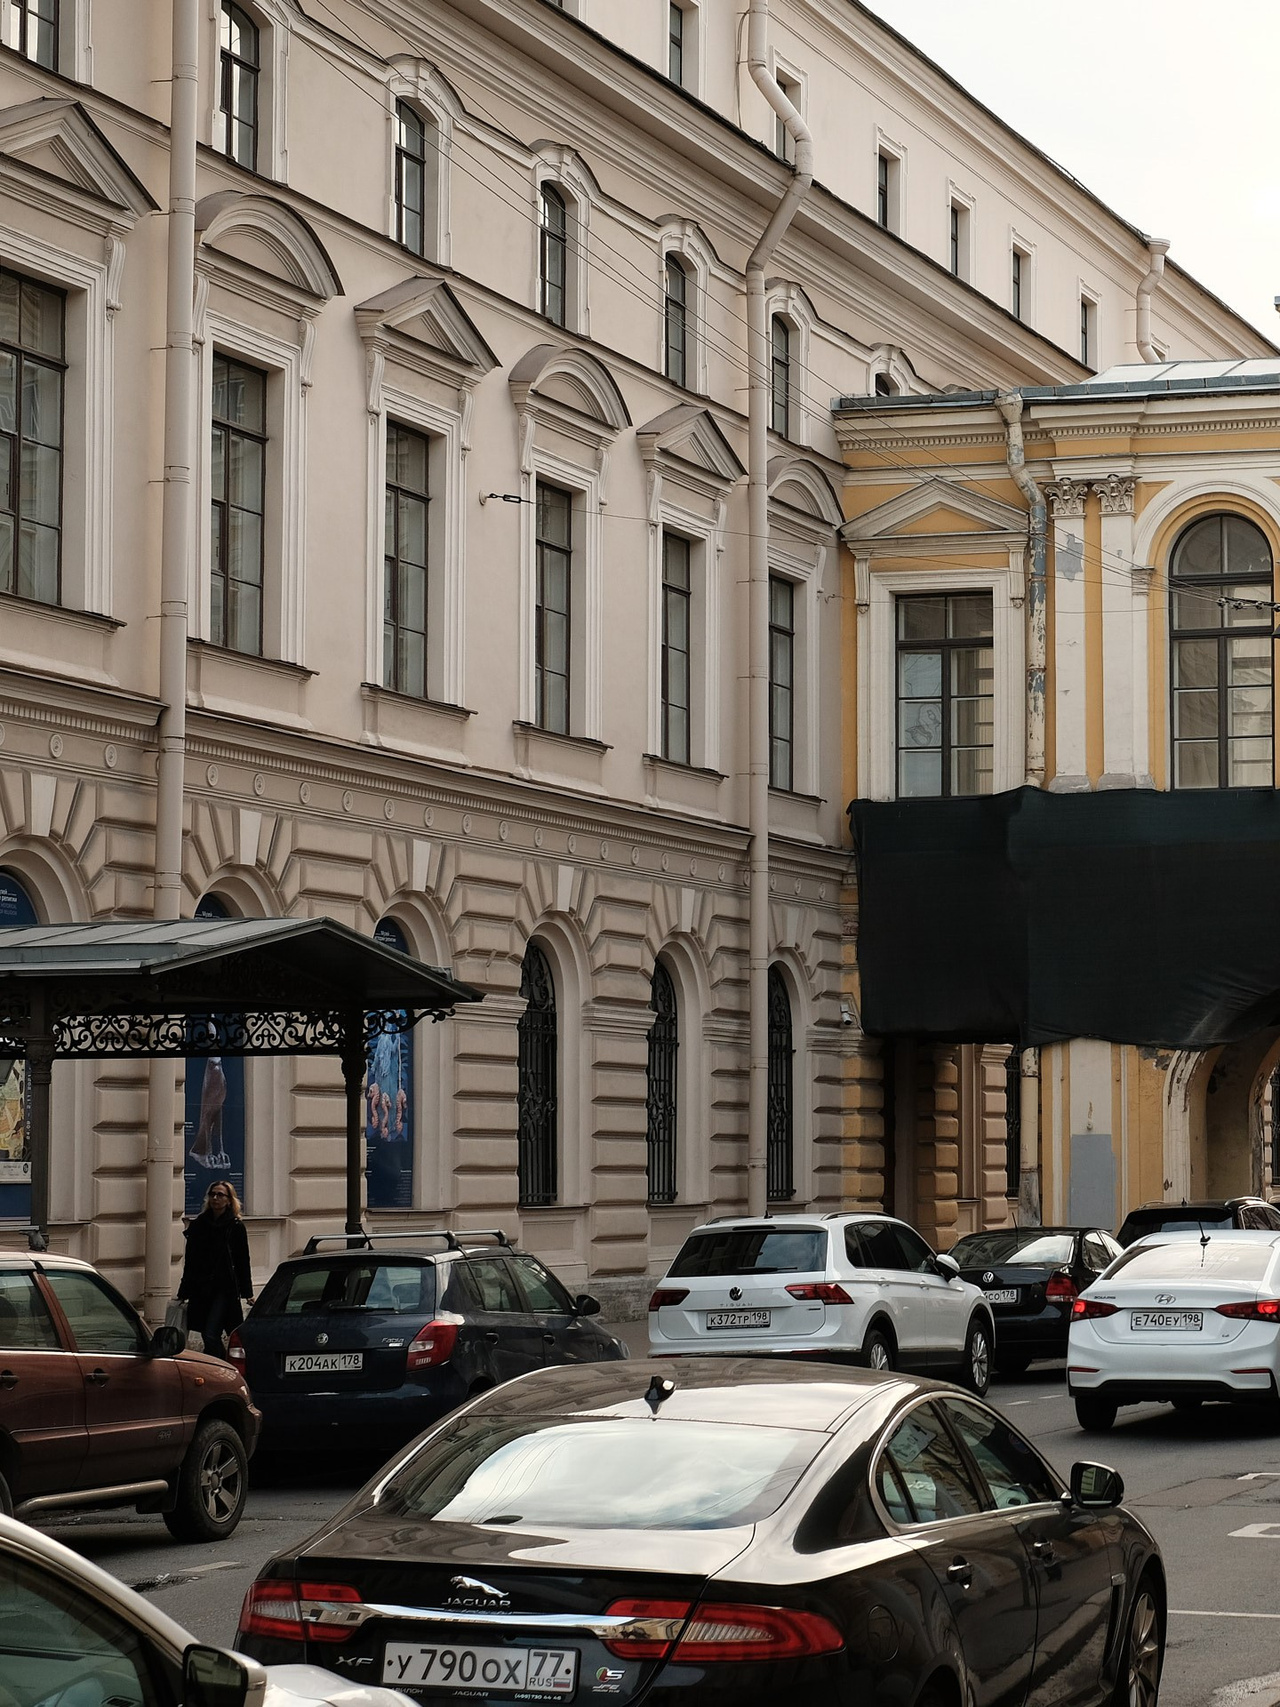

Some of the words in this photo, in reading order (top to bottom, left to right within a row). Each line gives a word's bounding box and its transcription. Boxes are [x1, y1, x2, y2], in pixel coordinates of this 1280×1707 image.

[1001, 1290, 1015, 1298] 178
[710, 1313, 750, 1325] К372ТР
[752, 1311, 767, 1320] 198
[1135, 1314, 1180, 1326] Е740ЕУ
[1182, 1314, 1199, 1323] 198
[289, 1357, 338, 1371] К204АК
[341, 1354, 360, 1365] 178
[441, 1597, 511, 1607] JAGUAR
[335, 1656, 374, 1667] XF
[397, 1648, 522, 1685] У790ОХ
[533, 1651, 565, 1678] 77
[529, 1677, 552, 1687] RUS
